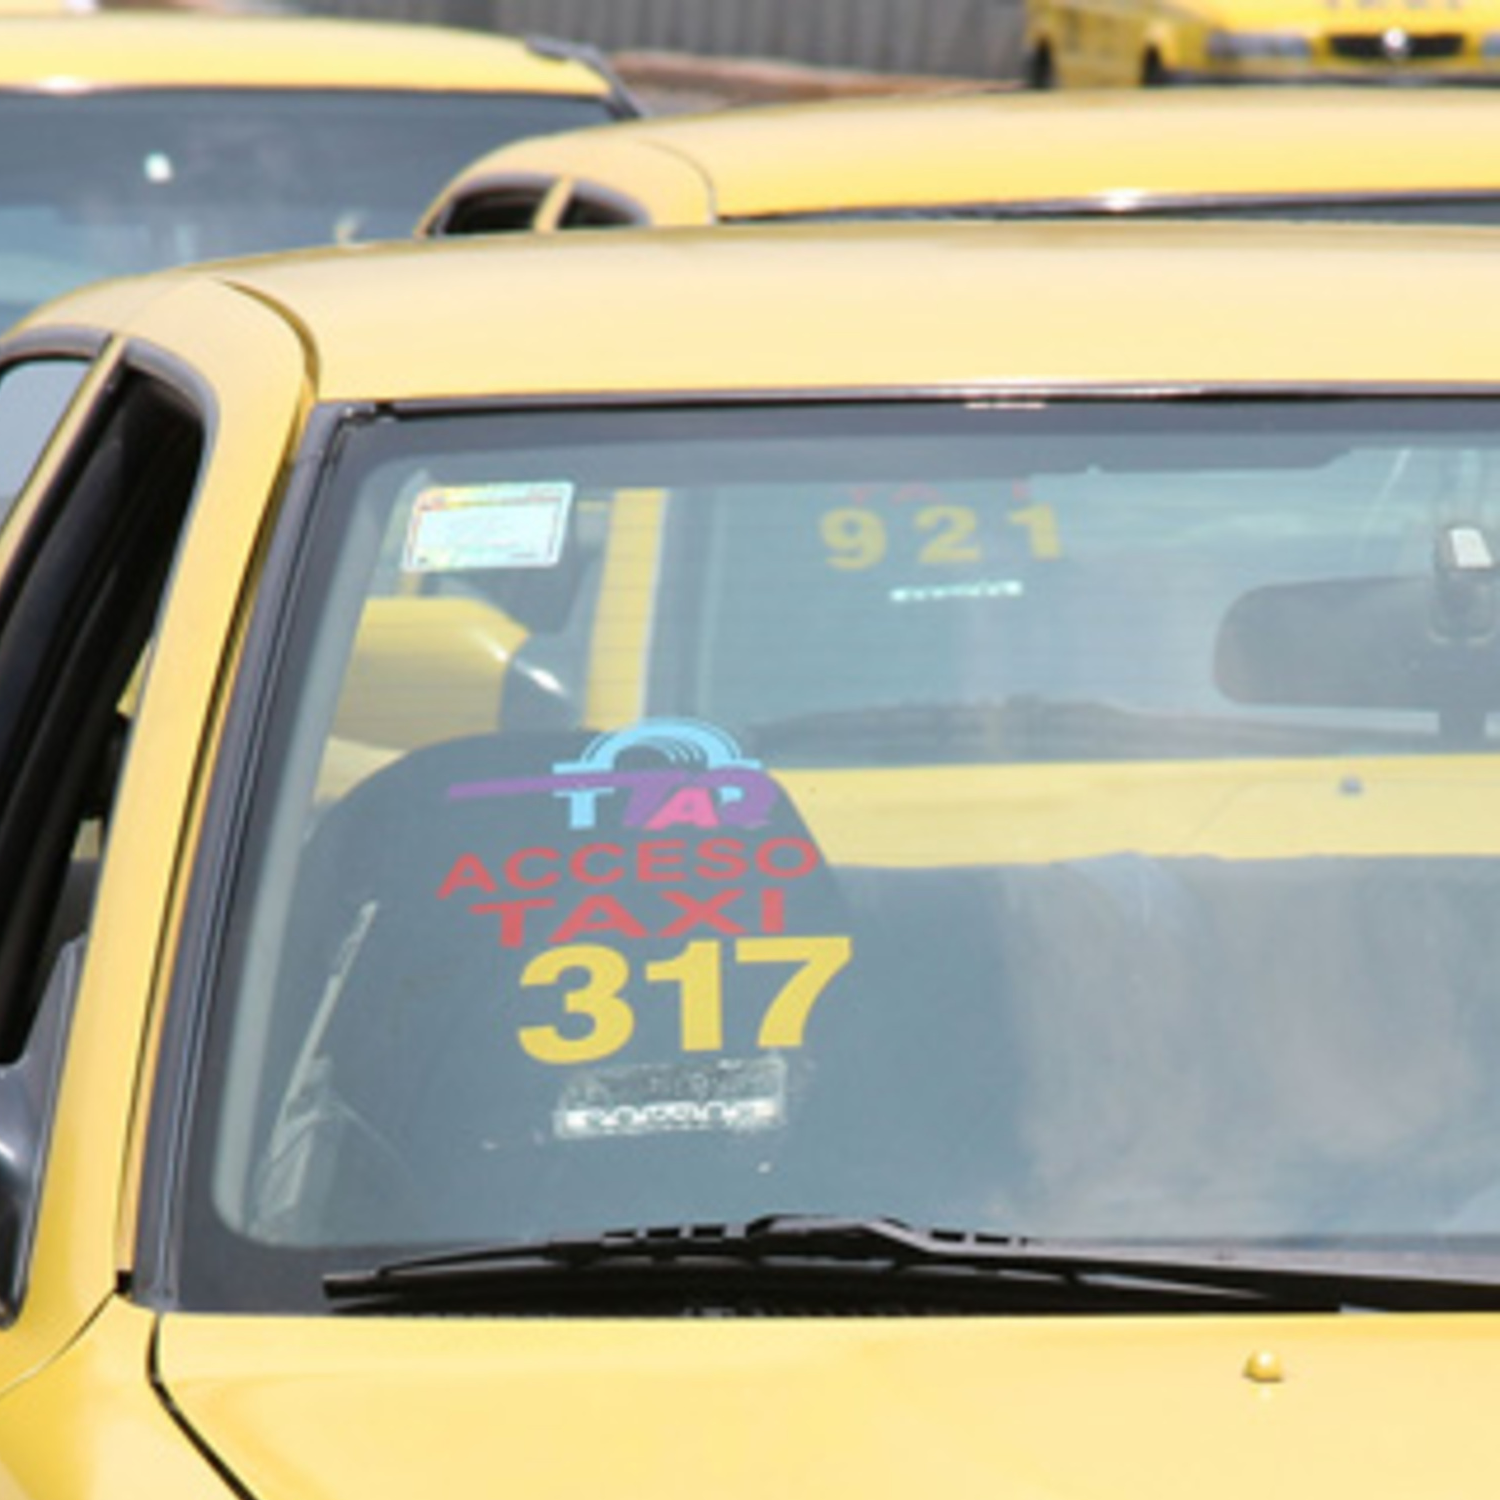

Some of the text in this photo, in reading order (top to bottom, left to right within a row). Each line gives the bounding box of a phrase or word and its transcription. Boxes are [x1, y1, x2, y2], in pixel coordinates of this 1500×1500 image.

[819, 503, 1063, 571] 921
[437, 836, 819, 900] ACCESO
[469, 888, 787, 948] TAXI
[517, 936, 853, 1065] 317
